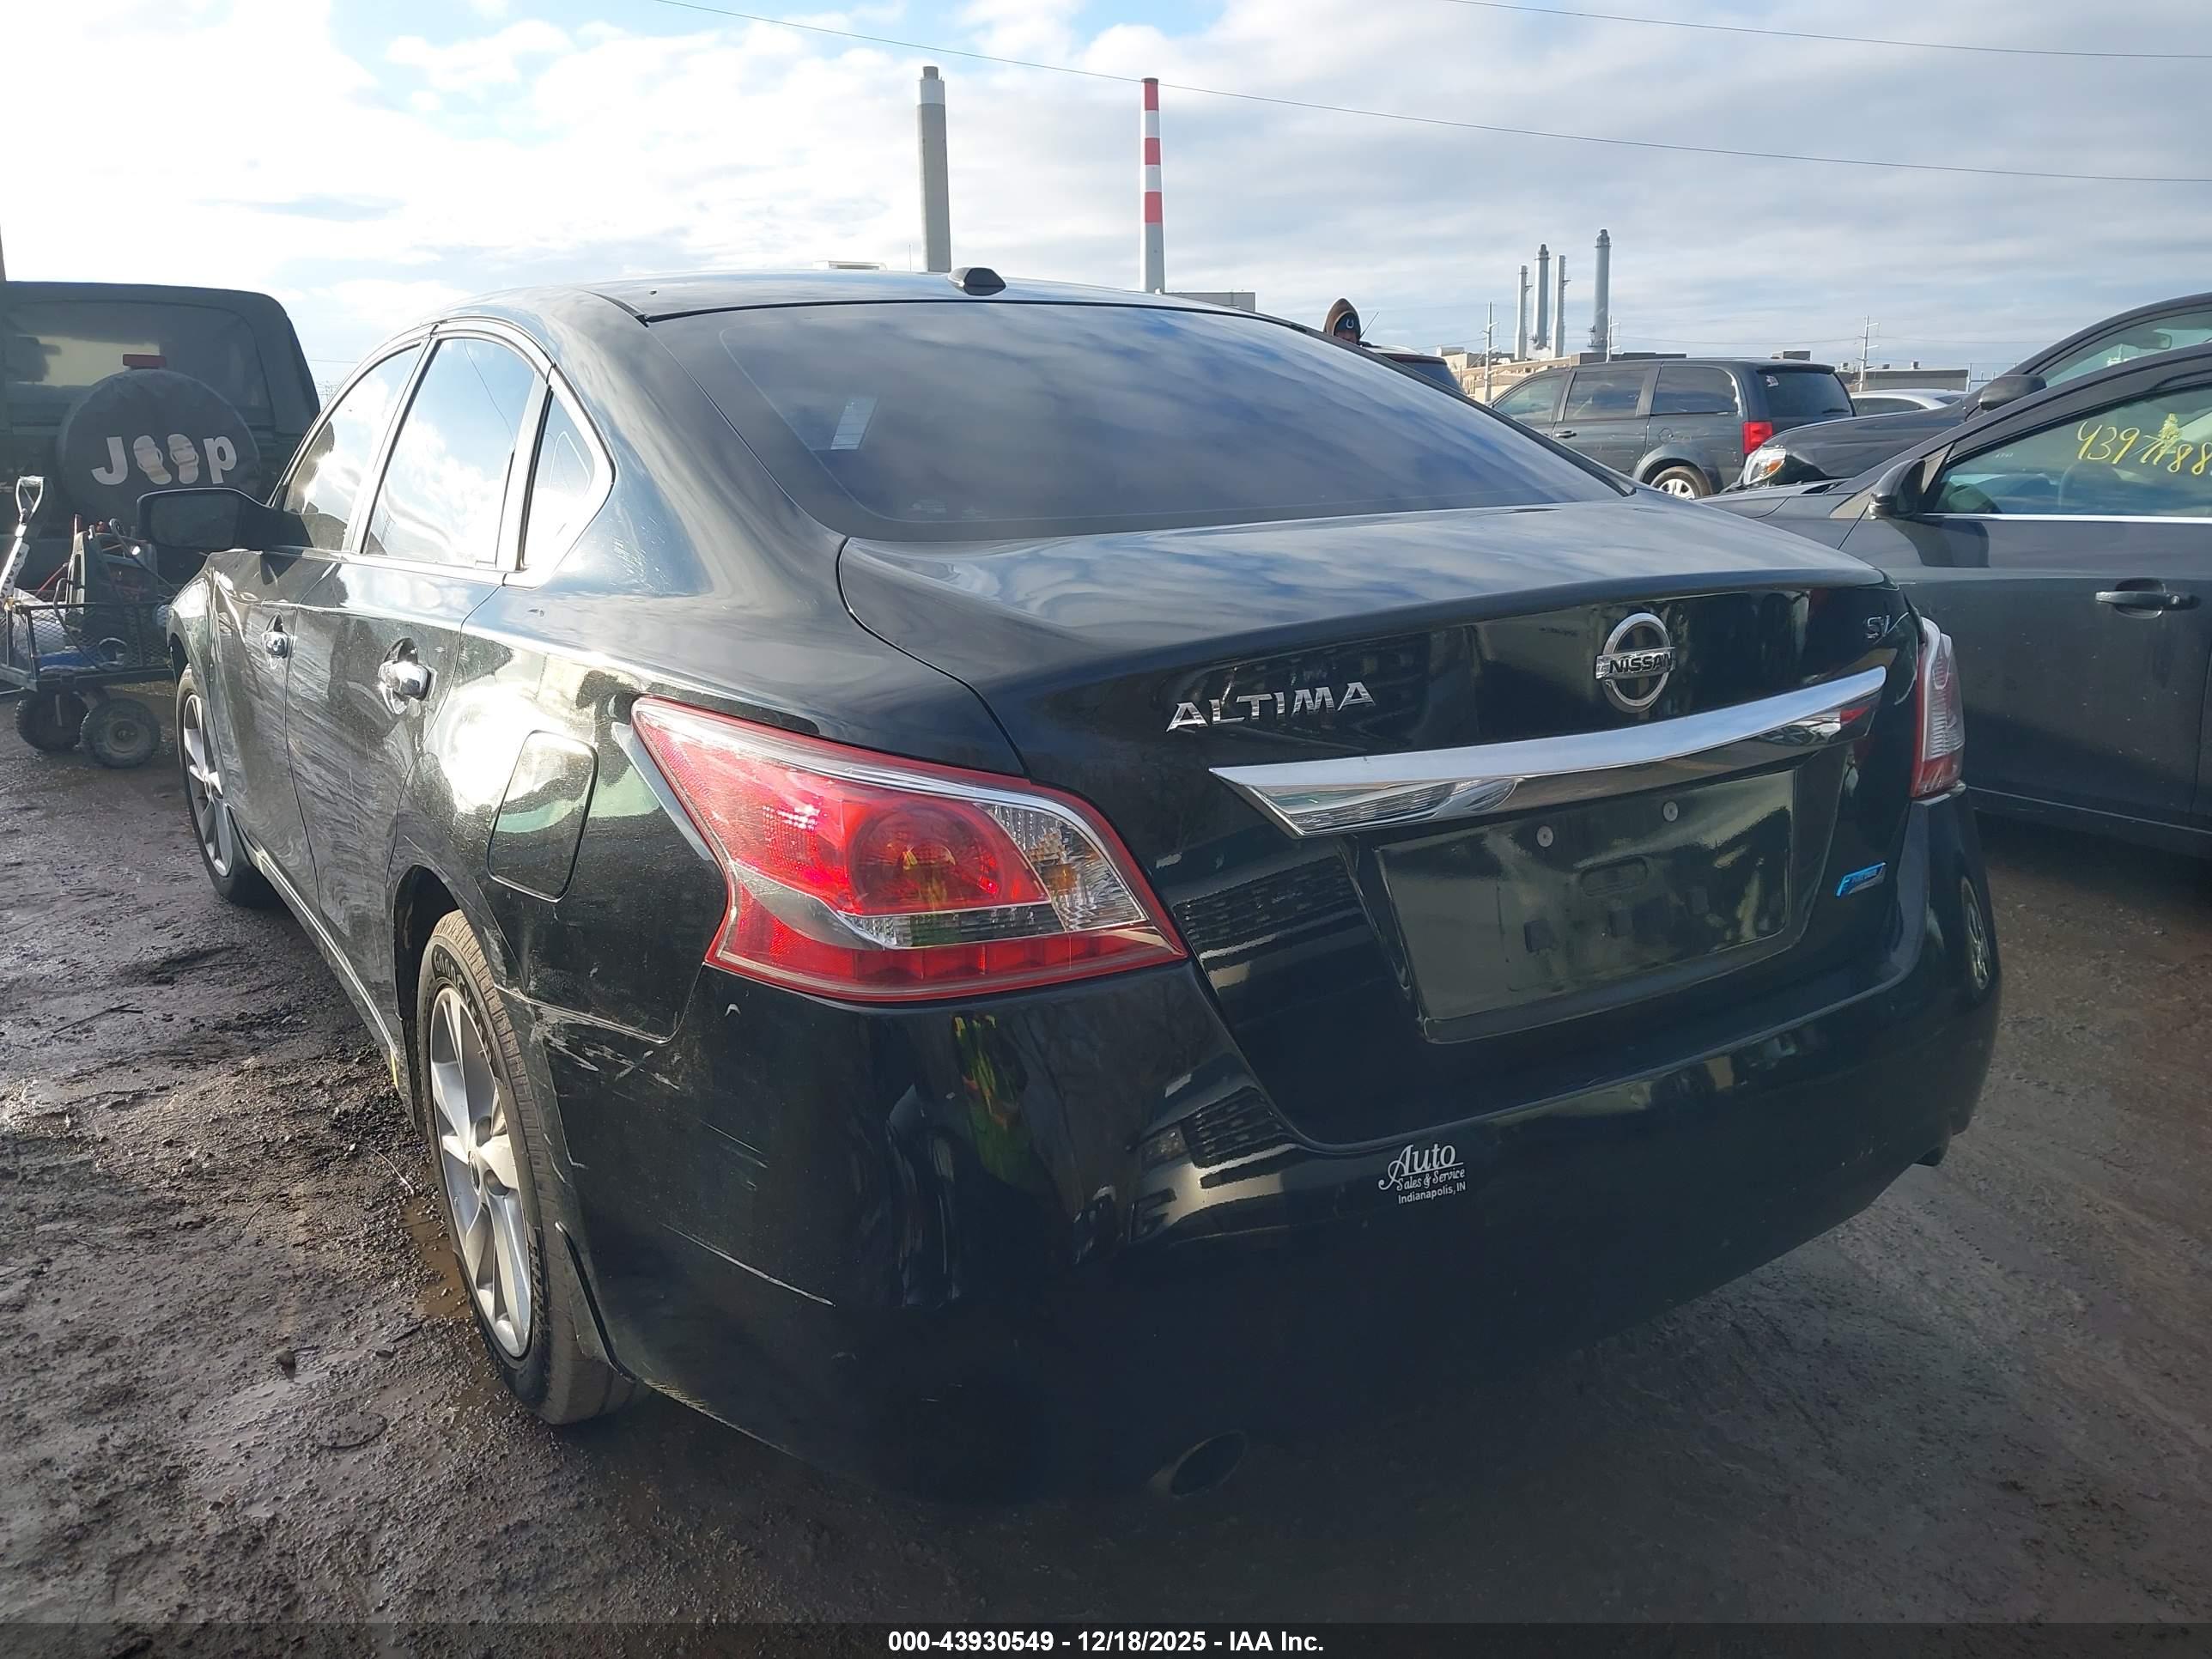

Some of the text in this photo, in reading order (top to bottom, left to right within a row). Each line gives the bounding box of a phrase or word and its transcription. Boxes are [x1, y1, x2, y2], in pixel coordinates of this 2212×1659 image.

[90, 434, 237, 485] Jp
[1608, 652, 1672, 674] NISSAN
[1166, 681, 1376, 732] ALTIMA
[1378, 1143, 1460, 1190] Auto
[1396, 1167, 1466, 1191] Sales & Service
[1398, 1181, 1467, 1204] Indianapolis, IN
